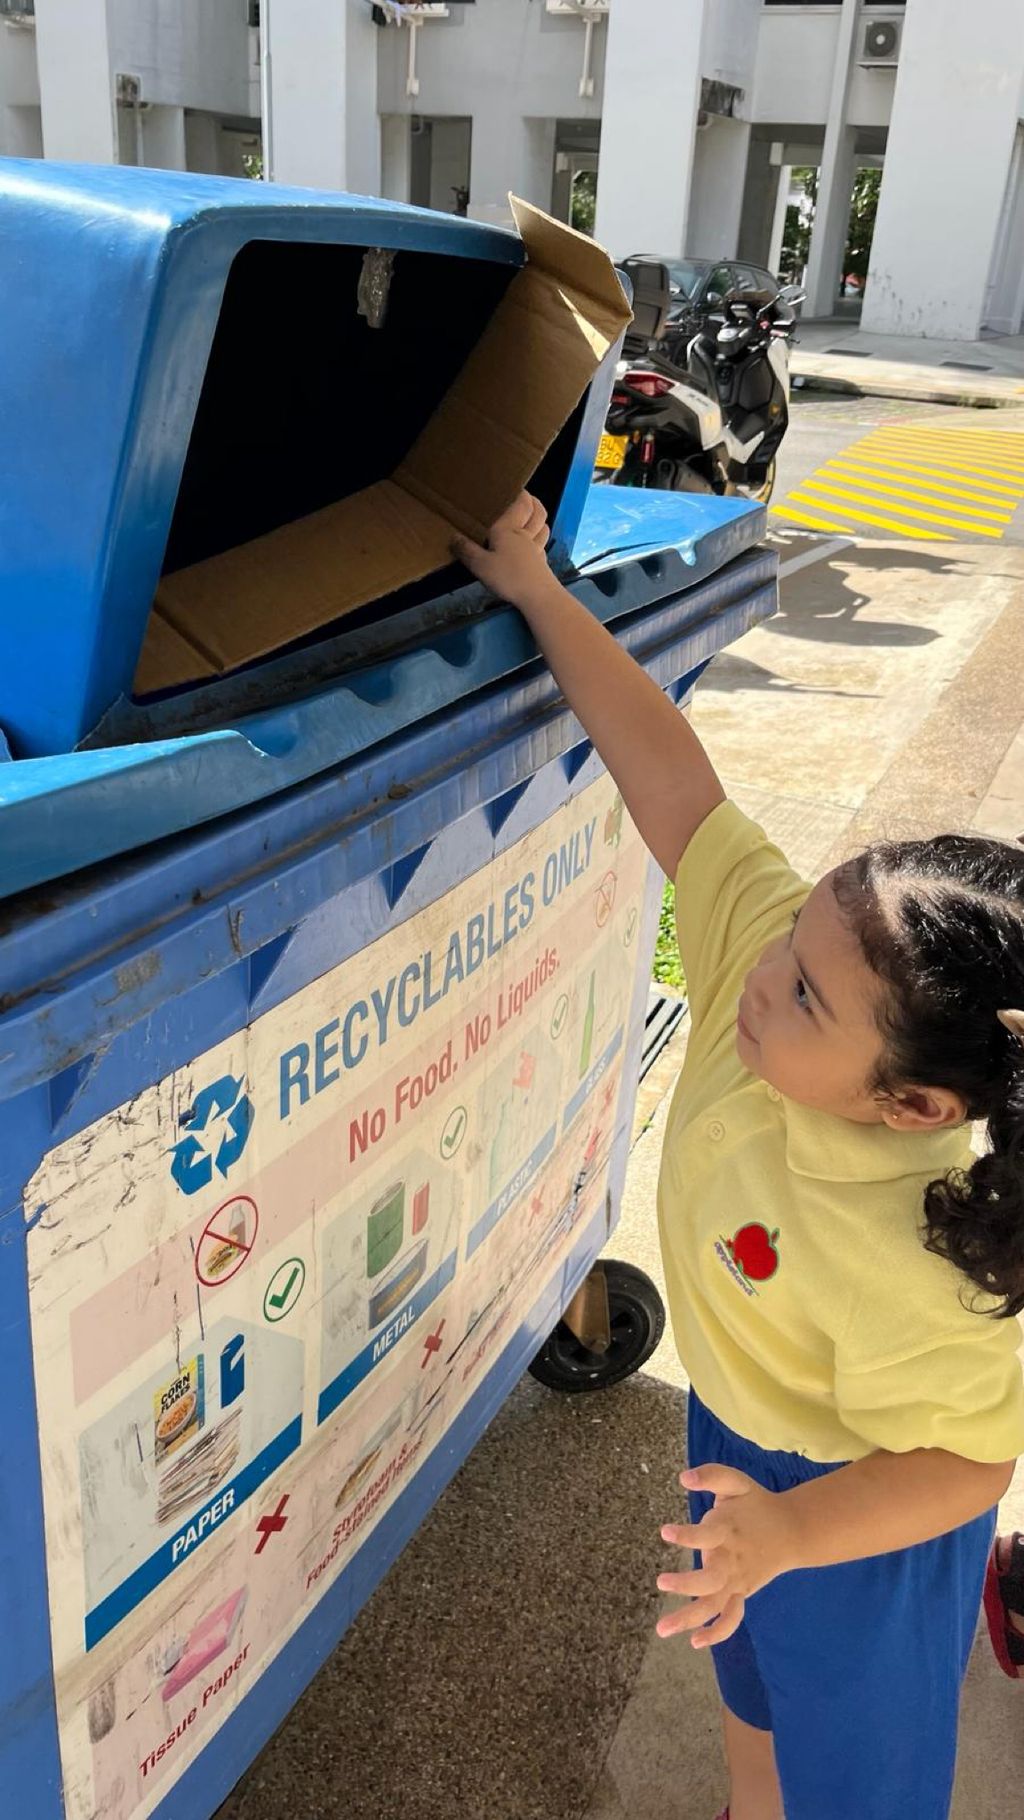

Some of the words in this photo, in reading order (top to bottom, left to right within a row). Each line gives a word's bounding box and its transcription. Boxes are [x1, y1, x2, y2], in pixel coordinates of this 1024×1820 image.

[279, 870, 535, 1121] RECYCLABLES
[542, 815, 598, 907] ONLY
[349, 1107, 386, 1163] No
[395, 1040, 458, 1124] Food.
[465, 1012, 492, 1062] No
[497, 948, 560, 1031] Liquids.
[372, 1304, 416, 1361] METAL
[161, 1372, 190, 1405] CORN
[161, 1382, 191, 1413] FLAKES
[171, 1488, 236, 1563] PAPER
[138, 1703, 198, 1778] Tissue
[202, 1642, 251, 1705] Paper
